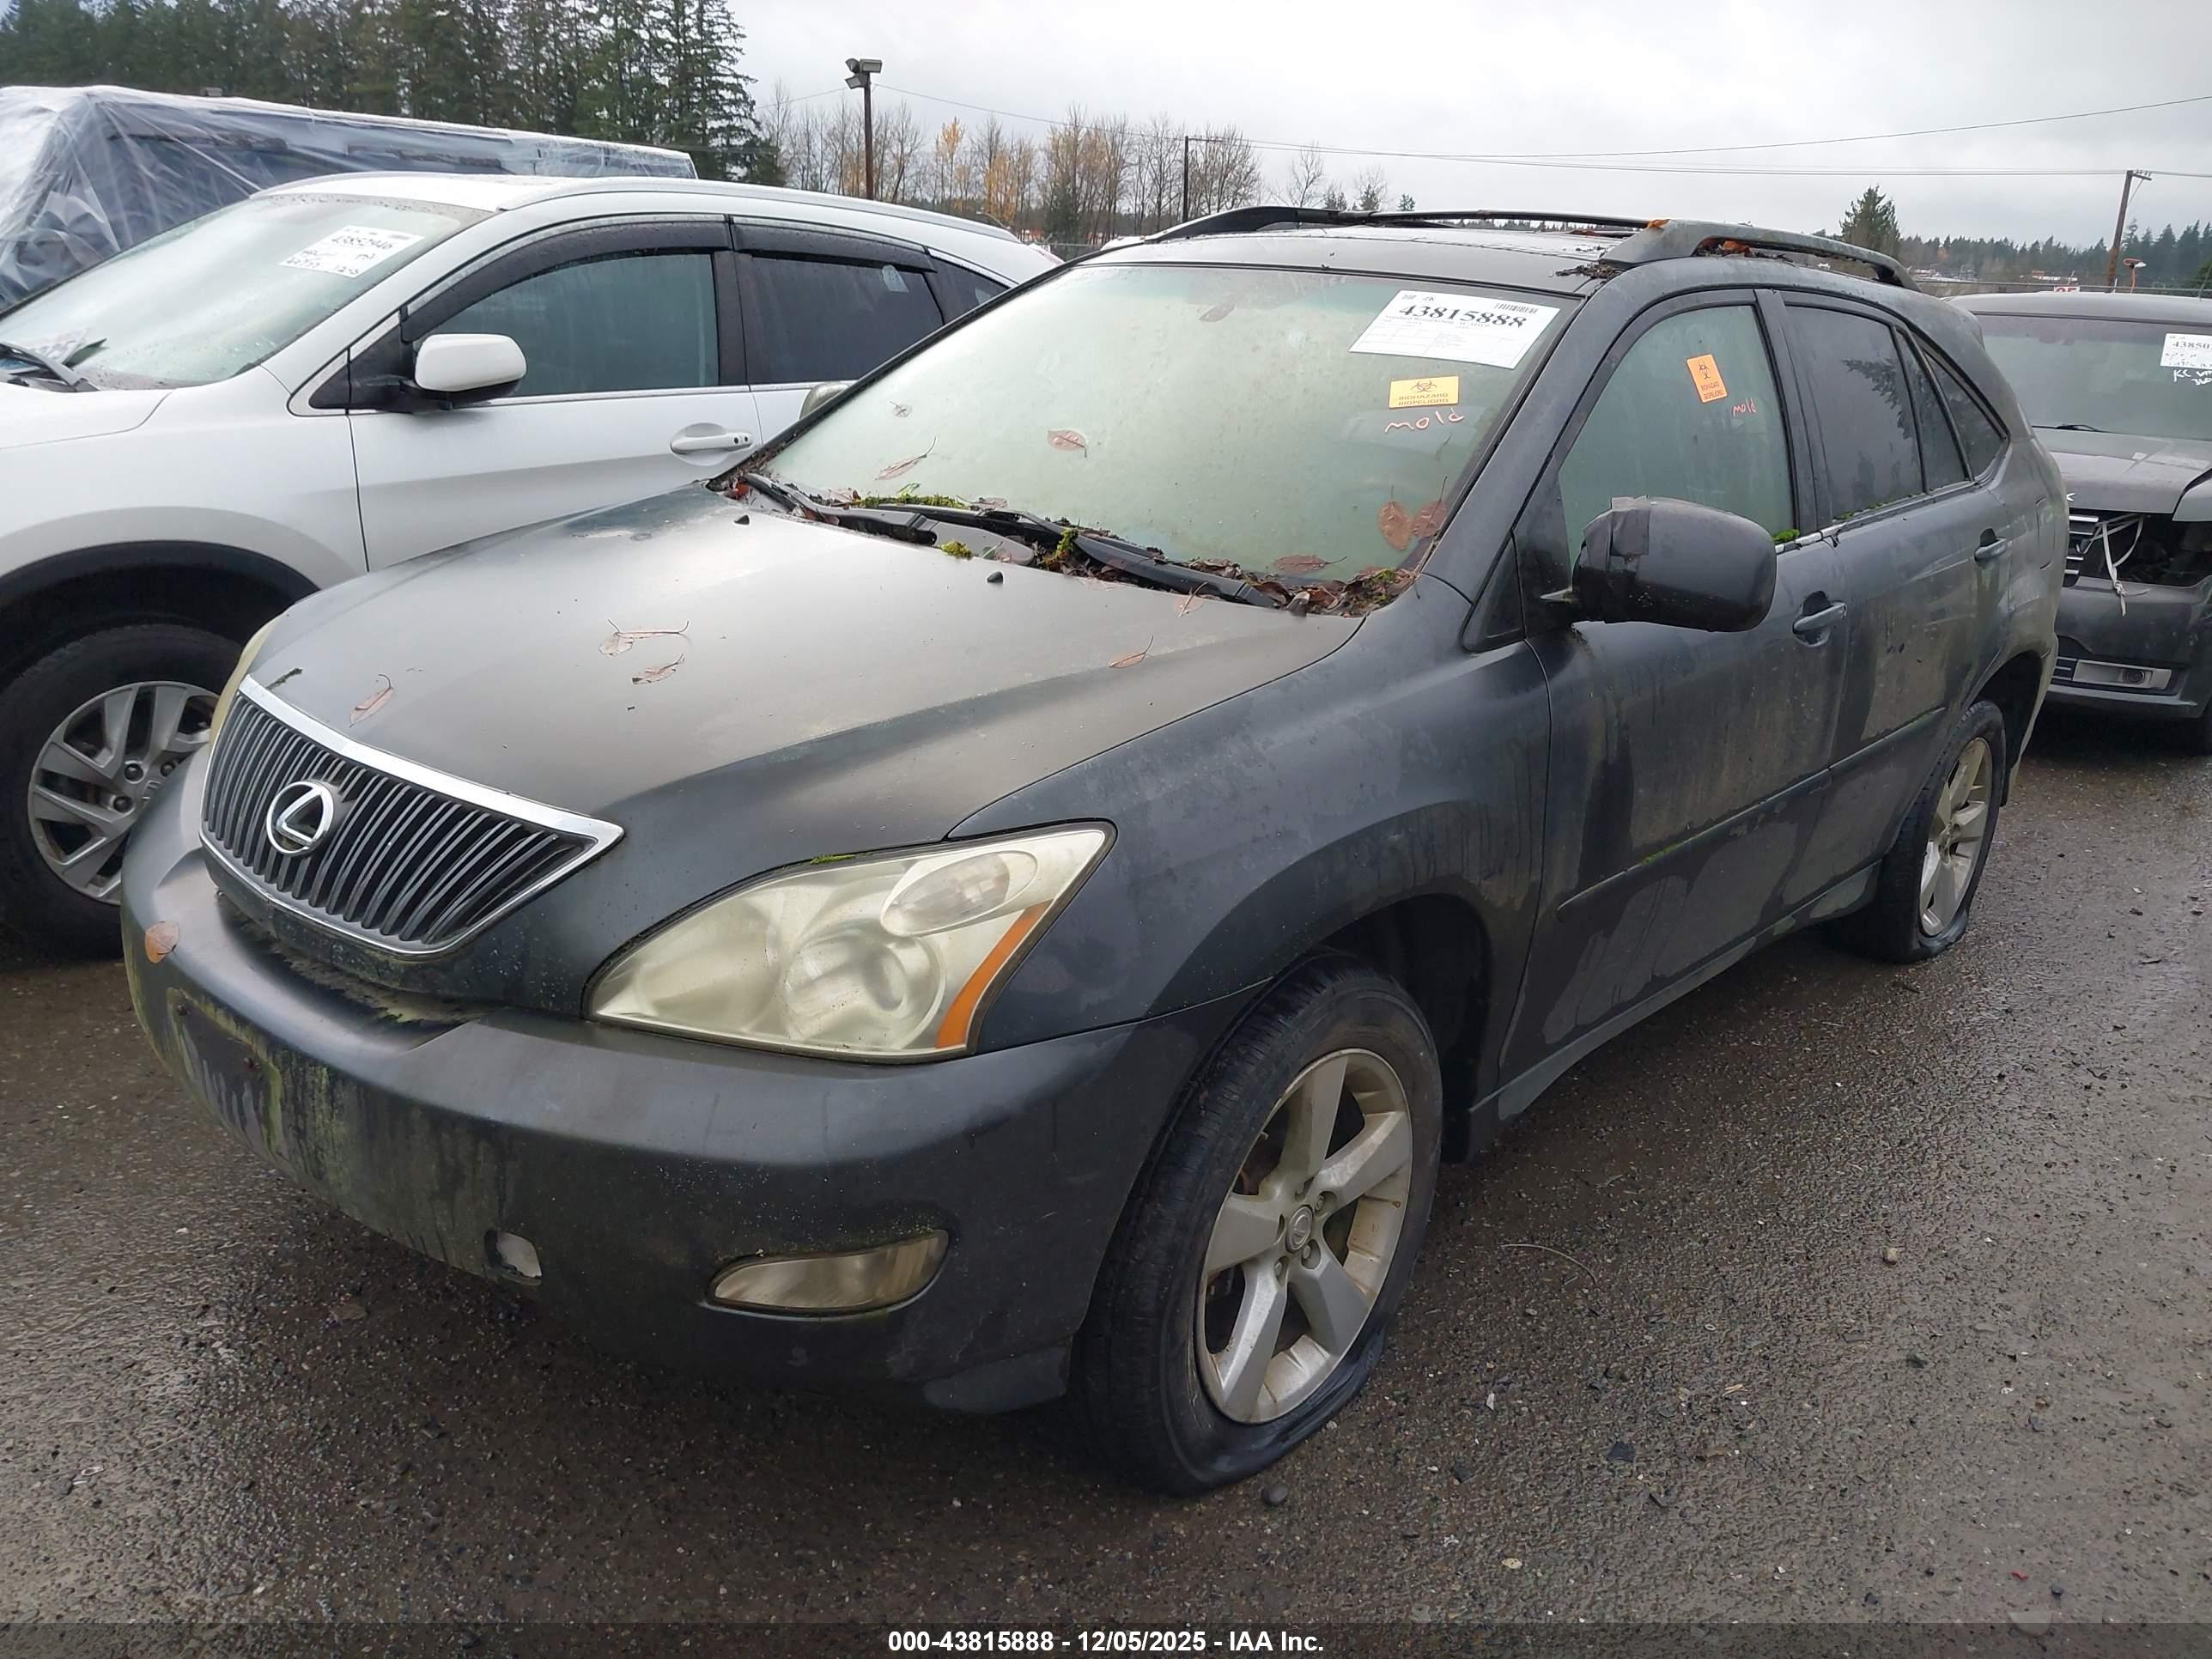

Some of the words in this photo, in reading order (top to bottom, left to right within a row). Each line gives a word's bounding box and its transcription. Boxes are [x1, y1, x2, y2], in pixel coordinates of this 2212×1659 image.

[1399, 305, 1527, 328] 43815888
[2172, 341, 2212, 350] 43850
[1384, 407, 1465, 434] mold
